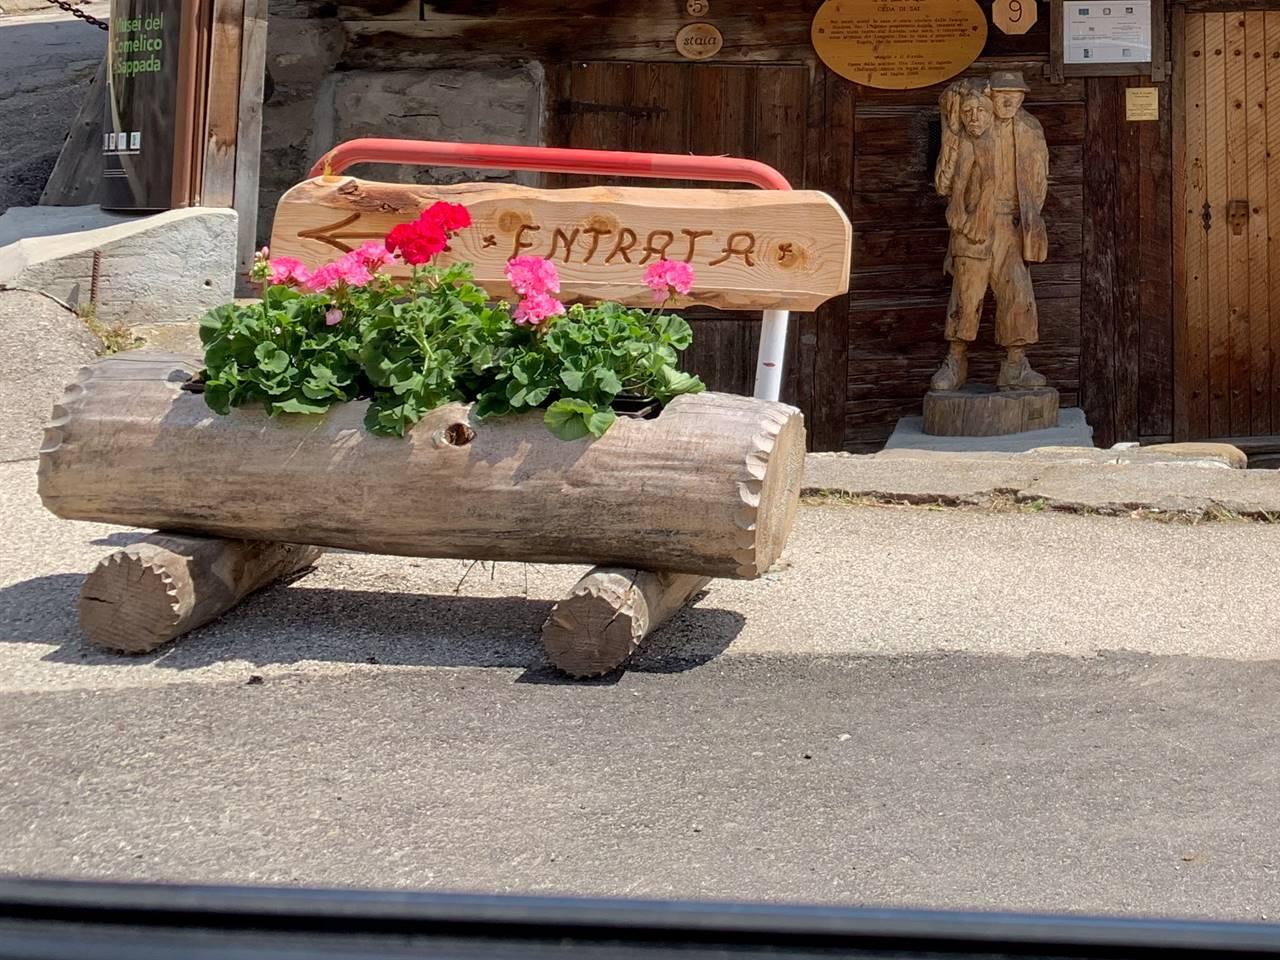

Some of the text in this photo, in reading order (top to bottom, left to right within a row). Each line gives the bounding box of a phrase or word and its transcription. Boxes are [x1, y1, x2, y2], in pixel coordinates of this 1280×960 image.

[145, 12, 164, 30] del
[1008, 0, 1022, 23] 9
[118, 54, 160, 77] Sappada
[508, 224, 755, 267] ENTRATA
